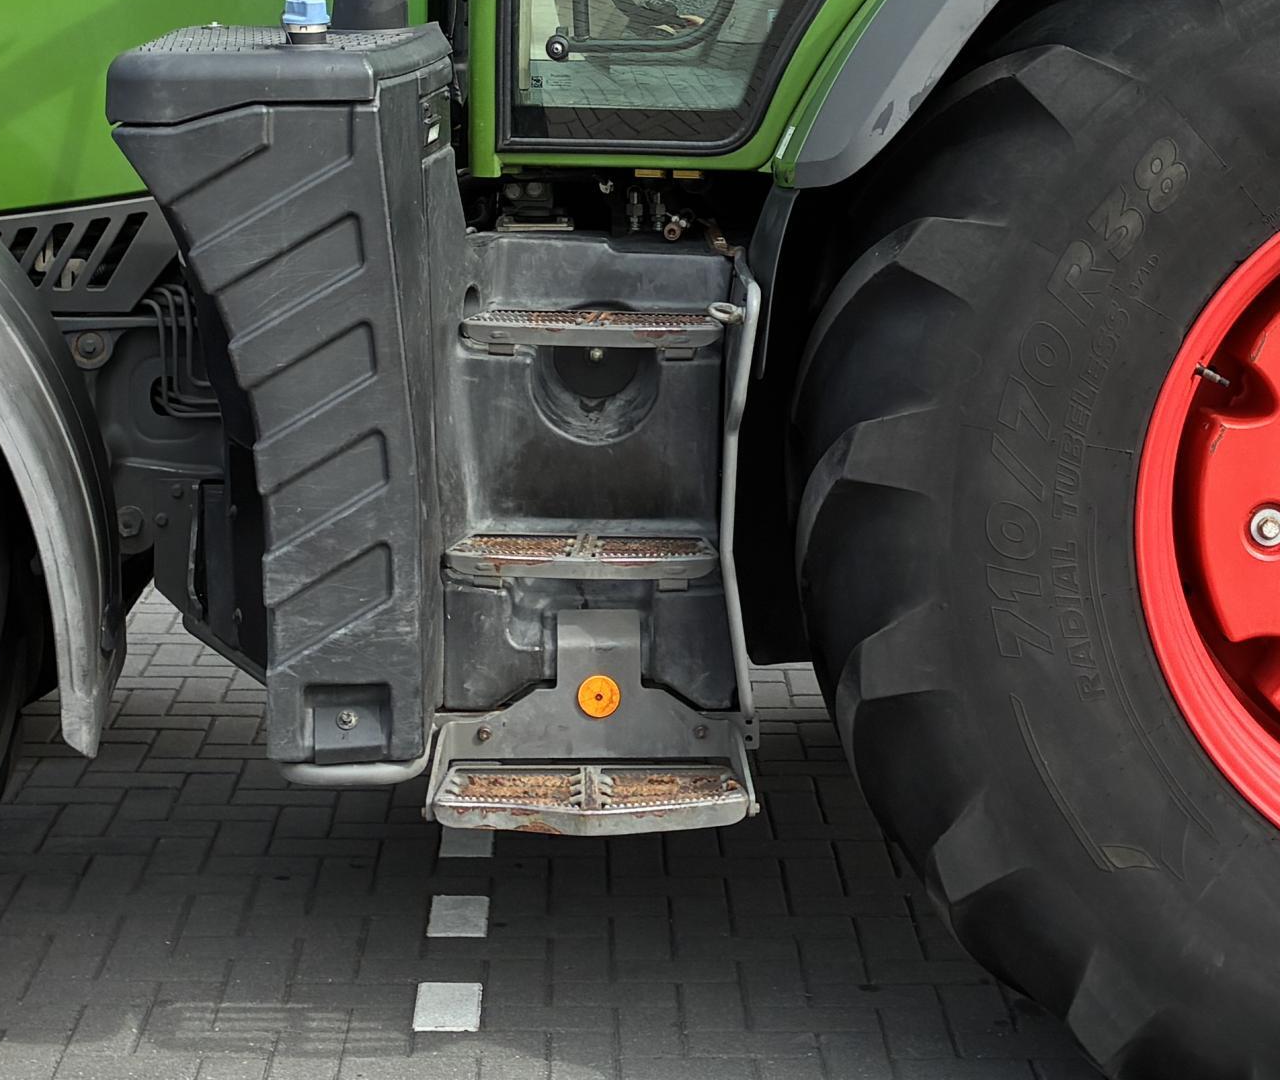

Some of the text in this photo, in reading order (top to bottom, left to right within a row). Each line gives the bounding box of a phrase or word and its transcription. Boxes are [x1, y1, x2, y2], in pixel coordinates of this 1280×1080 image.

[985, 135, 1190, 659] 710/70 R38
[1051, 307, 1132, 520] TUBELESS
[1050, 539, 1106, 703] RADIAL
